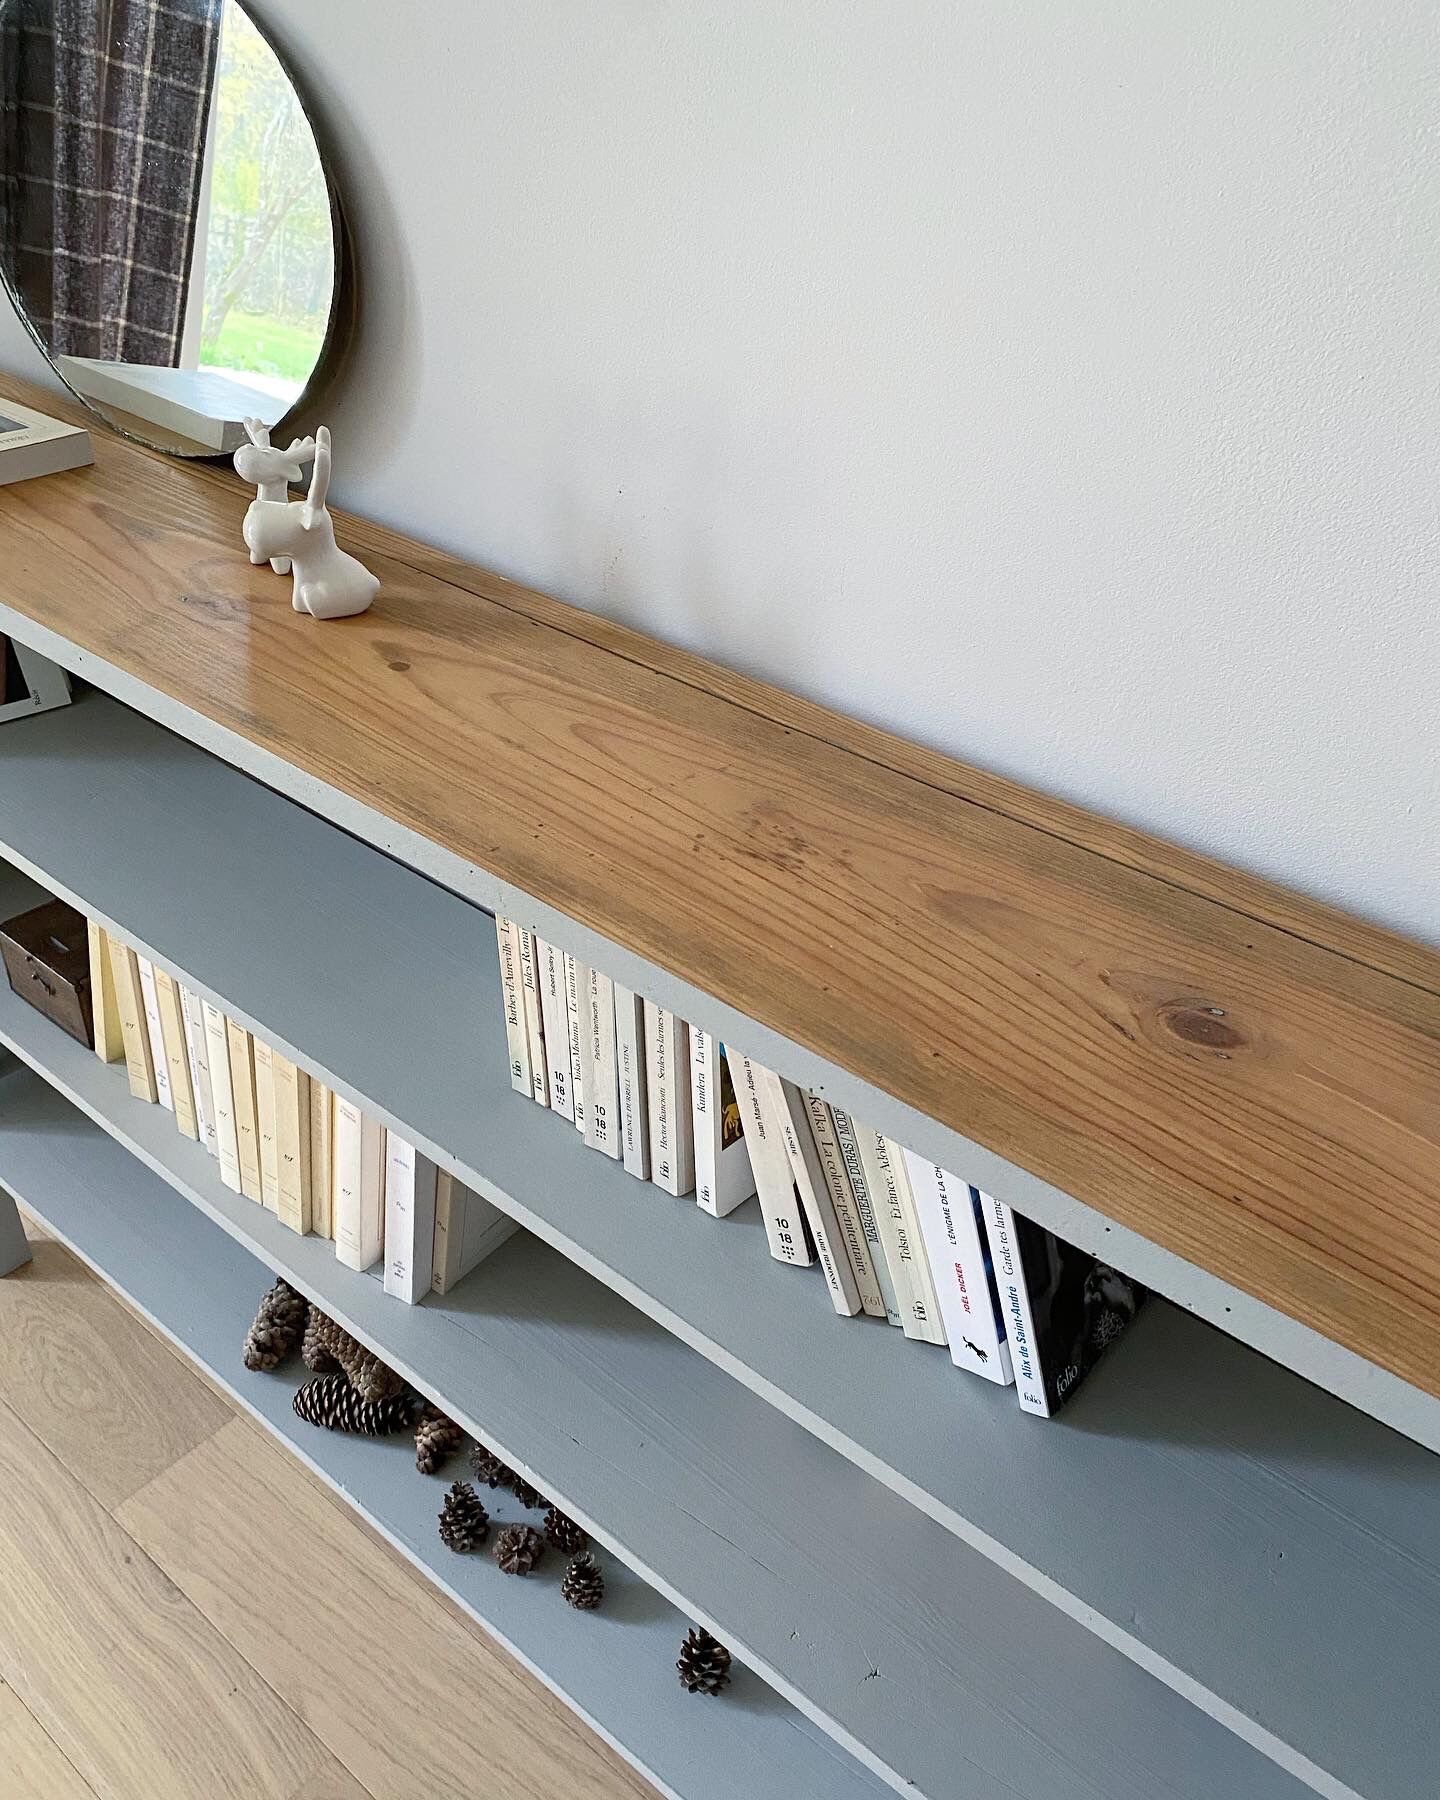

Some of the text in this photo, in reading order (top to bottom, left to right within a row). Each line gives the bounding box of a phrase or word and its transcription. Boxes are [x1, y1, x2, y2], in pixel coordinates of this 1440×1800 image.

[524, 965, 535, 992] Jules
[508, 992, 518, 1026] Barbey
[592, 1037, 601, 1061] Patricia
[695, 1052, 705, 1065] La
[554, 1071, 564, 1083] 10
[747, 1069, 757, 1091] Adieu
[555, 1084, 566, 1096] 18
[696, 1072, 706, 1113] Kundera
[595, 1105, 606, 1116] 10
[808, 1096, 828, 1133] Kafka
[595, 1118, 606, 1130] 18
[660, 1128, 668, 1150] Hector
[821, 1142, 833, 1159] La
[844, 1142, 862, 1176] DURAS
[875, 1129, 890, 1173] Adolesc
[826, 1158, 846, 1205] colonie
[938, 1178, 948, 1189] LA
[941, 1189, 951, 1202] DE
[853, 1175, 879, 1244] MARGUERITE
[775, 1218, 789, 1229] 10
[778, 1233, 793, 1244] 18
[996, 1228, 1008, 1245] tes
[996, 1245, 1014, 1276] Garde
[955, 1263, 971, 1314] JOËL DICKER
[1007, 1286, 1033, 1380] Alix de Saint-André
[1055, 1365, 1080, 1397] folio
